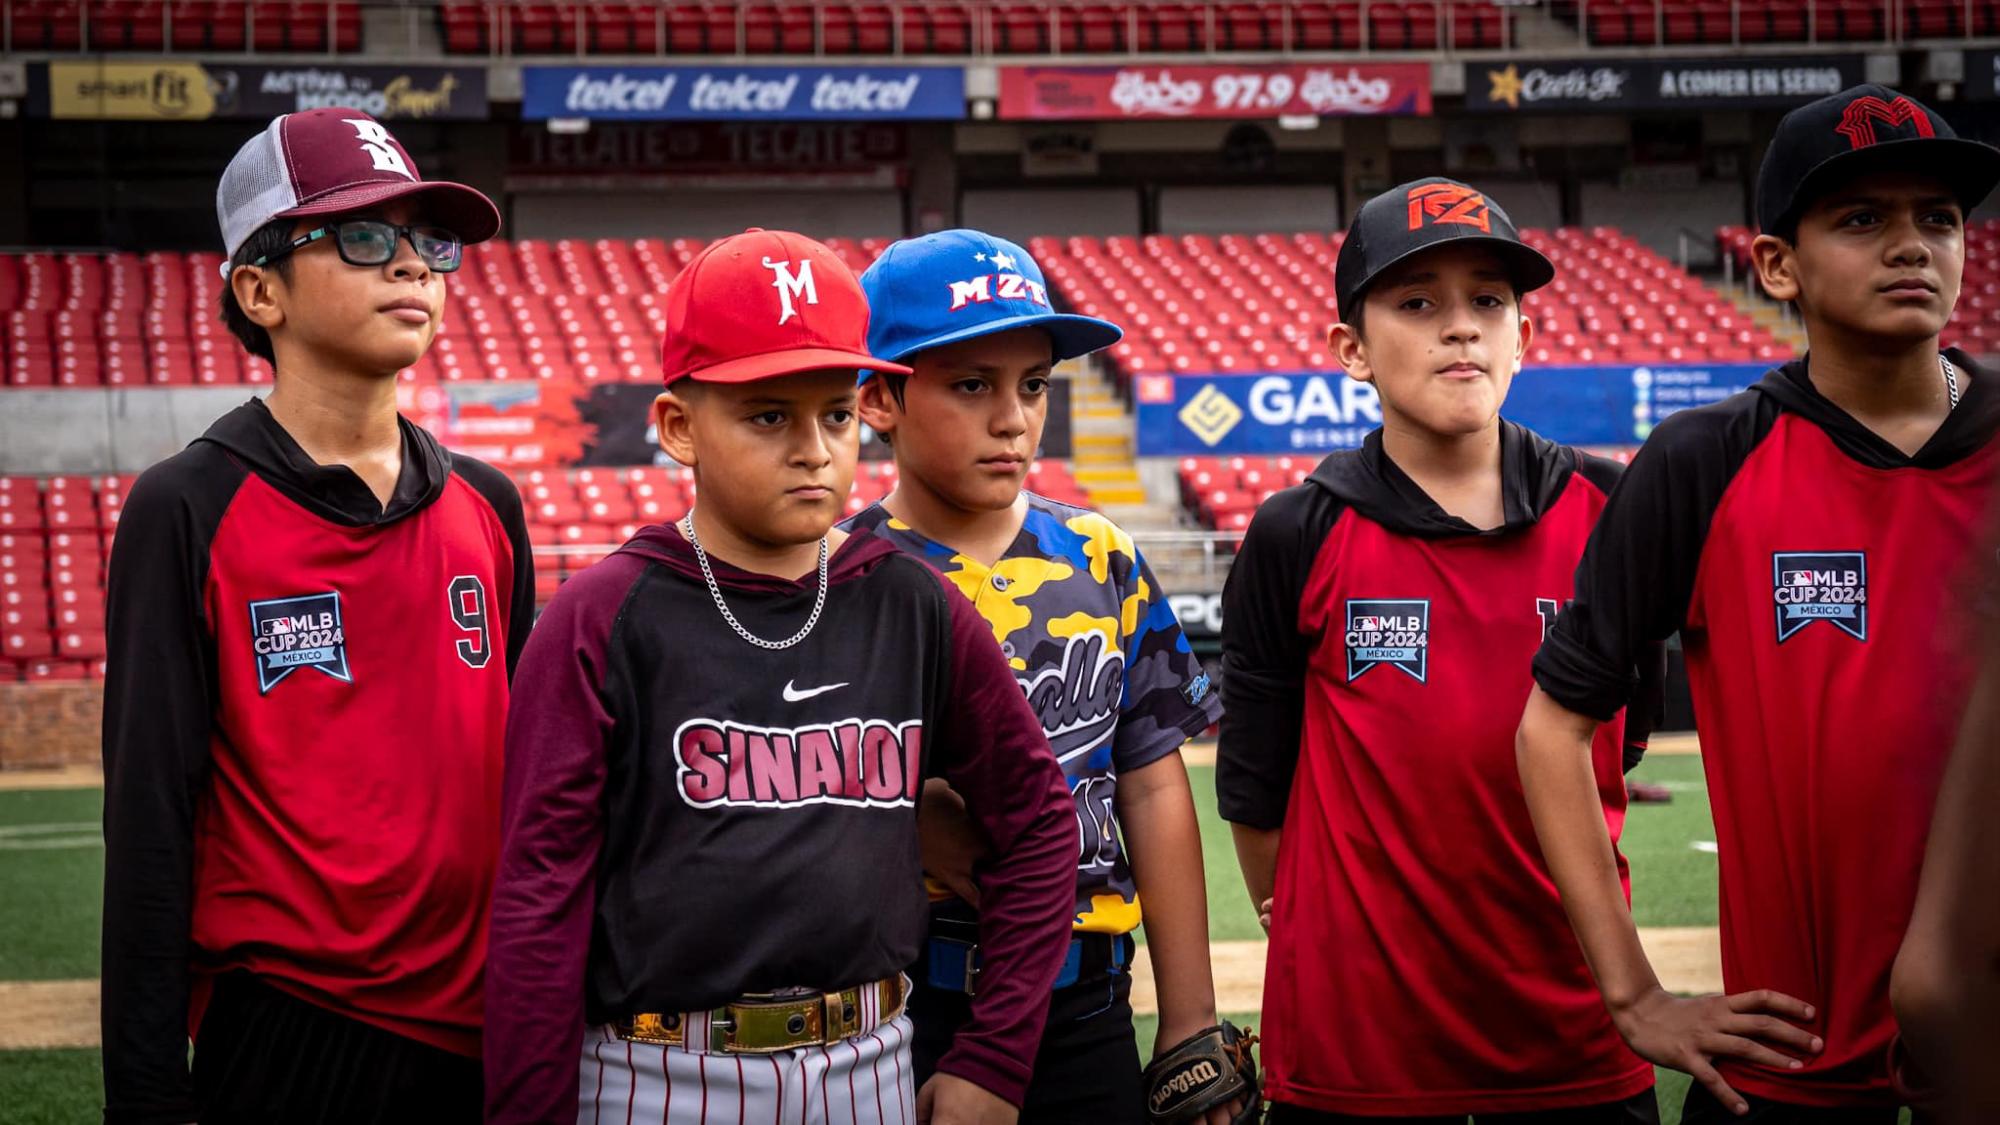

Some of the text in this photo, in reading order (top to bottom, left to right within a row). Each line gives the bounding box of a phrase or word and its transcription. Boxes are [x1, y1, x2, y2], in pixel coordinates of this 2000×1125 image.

[566, 73, 920, 110] telcel telcel telcel
[1212, 74, 1294, 108] 97.9
[1659, 66, 1842, 97] A COMER EN SERIO
[720, 124, 865, 162] TECATE
[761, 255, 819, 326] M
[946, 273, 1047, 313] MZT
[1813, 570, 1858, 587] MLB
[1774, 587, 1866, 604] CUP 2024
[290, 612, 334, 633] MLB
[447, 575, 492, 669] 9
[1379, 616, 1420, 632] MLB
[254, 627, 344, 655] CUP 2024
[1345, 631, 1428, 648] CUP 2024
[1153, 1061, 1218, 1107] Wilson
